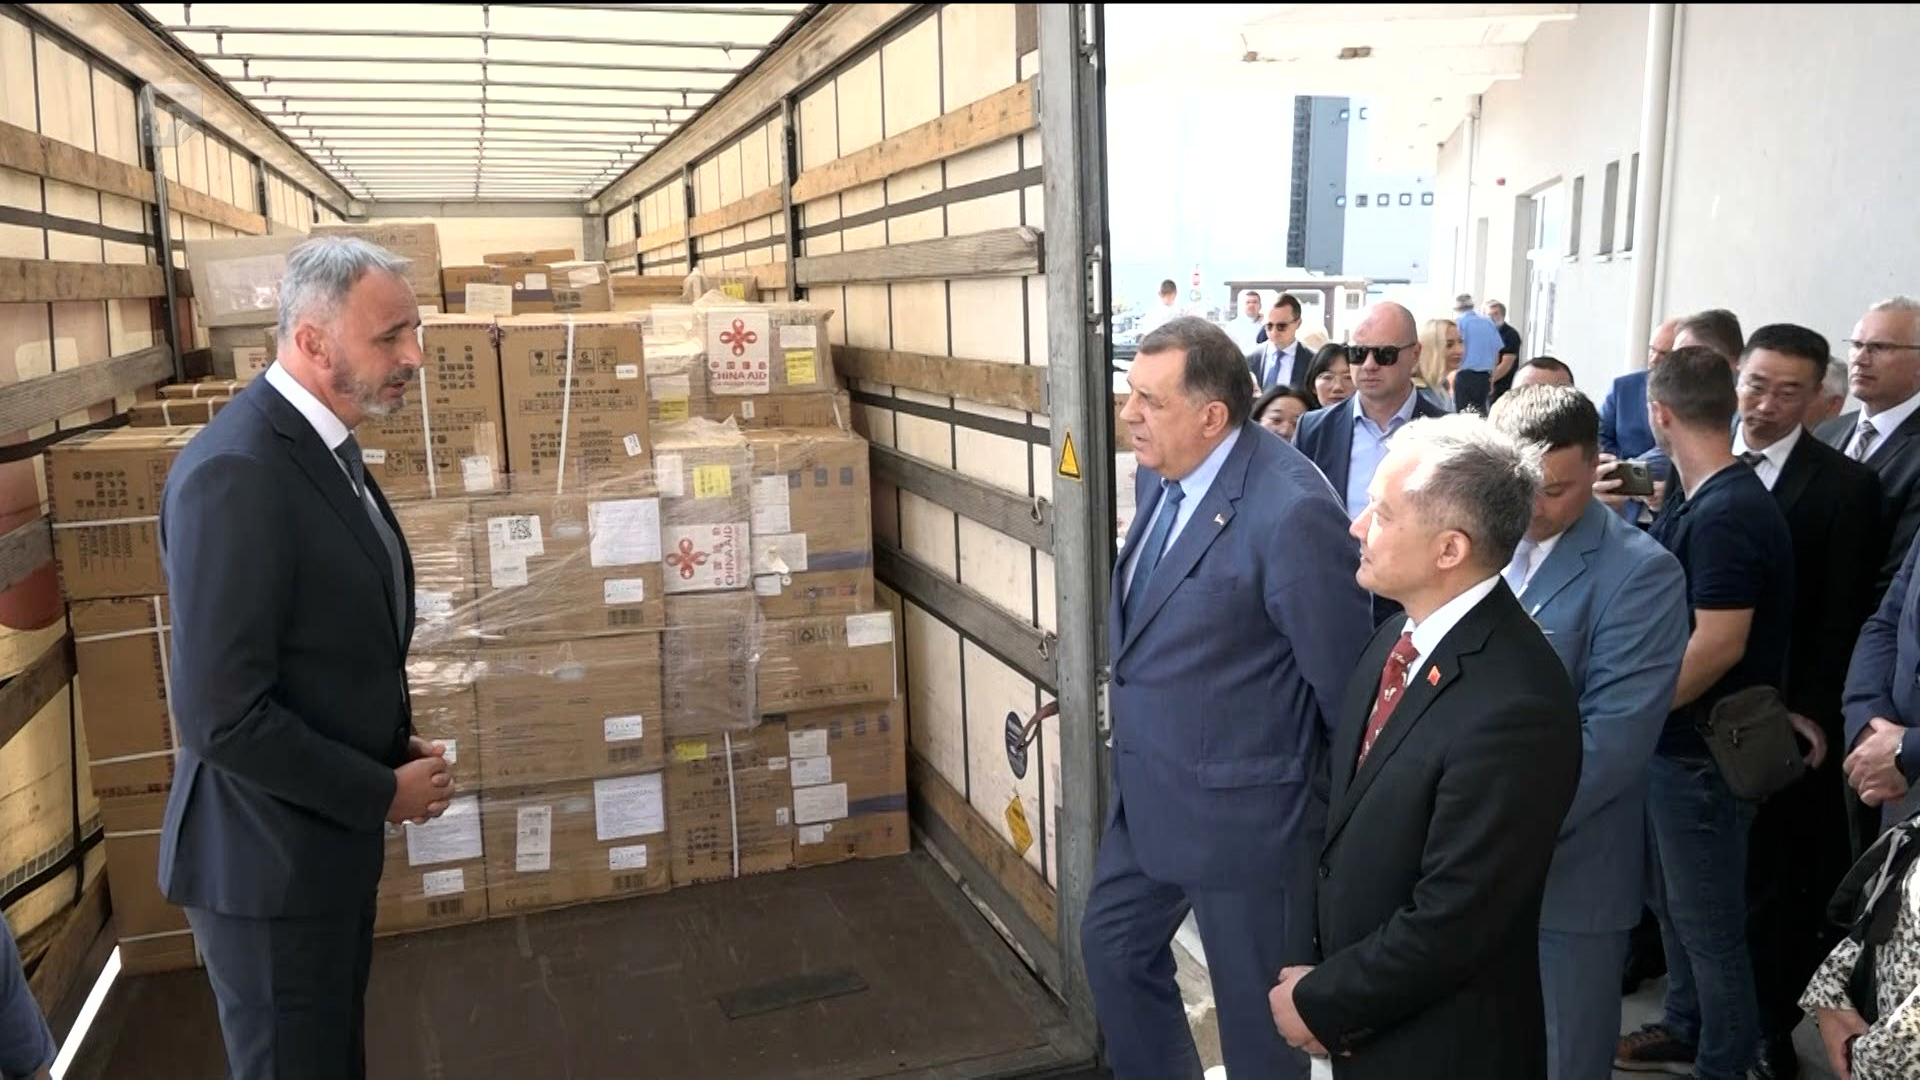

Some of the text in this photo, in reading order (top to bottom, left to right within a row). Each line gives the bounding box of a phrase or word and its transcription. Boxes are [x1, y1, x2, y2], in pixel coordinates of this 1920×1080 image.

[711, 371, 767, 380] CHINA AID
[723, 525, 734, 586] CHINA AID
